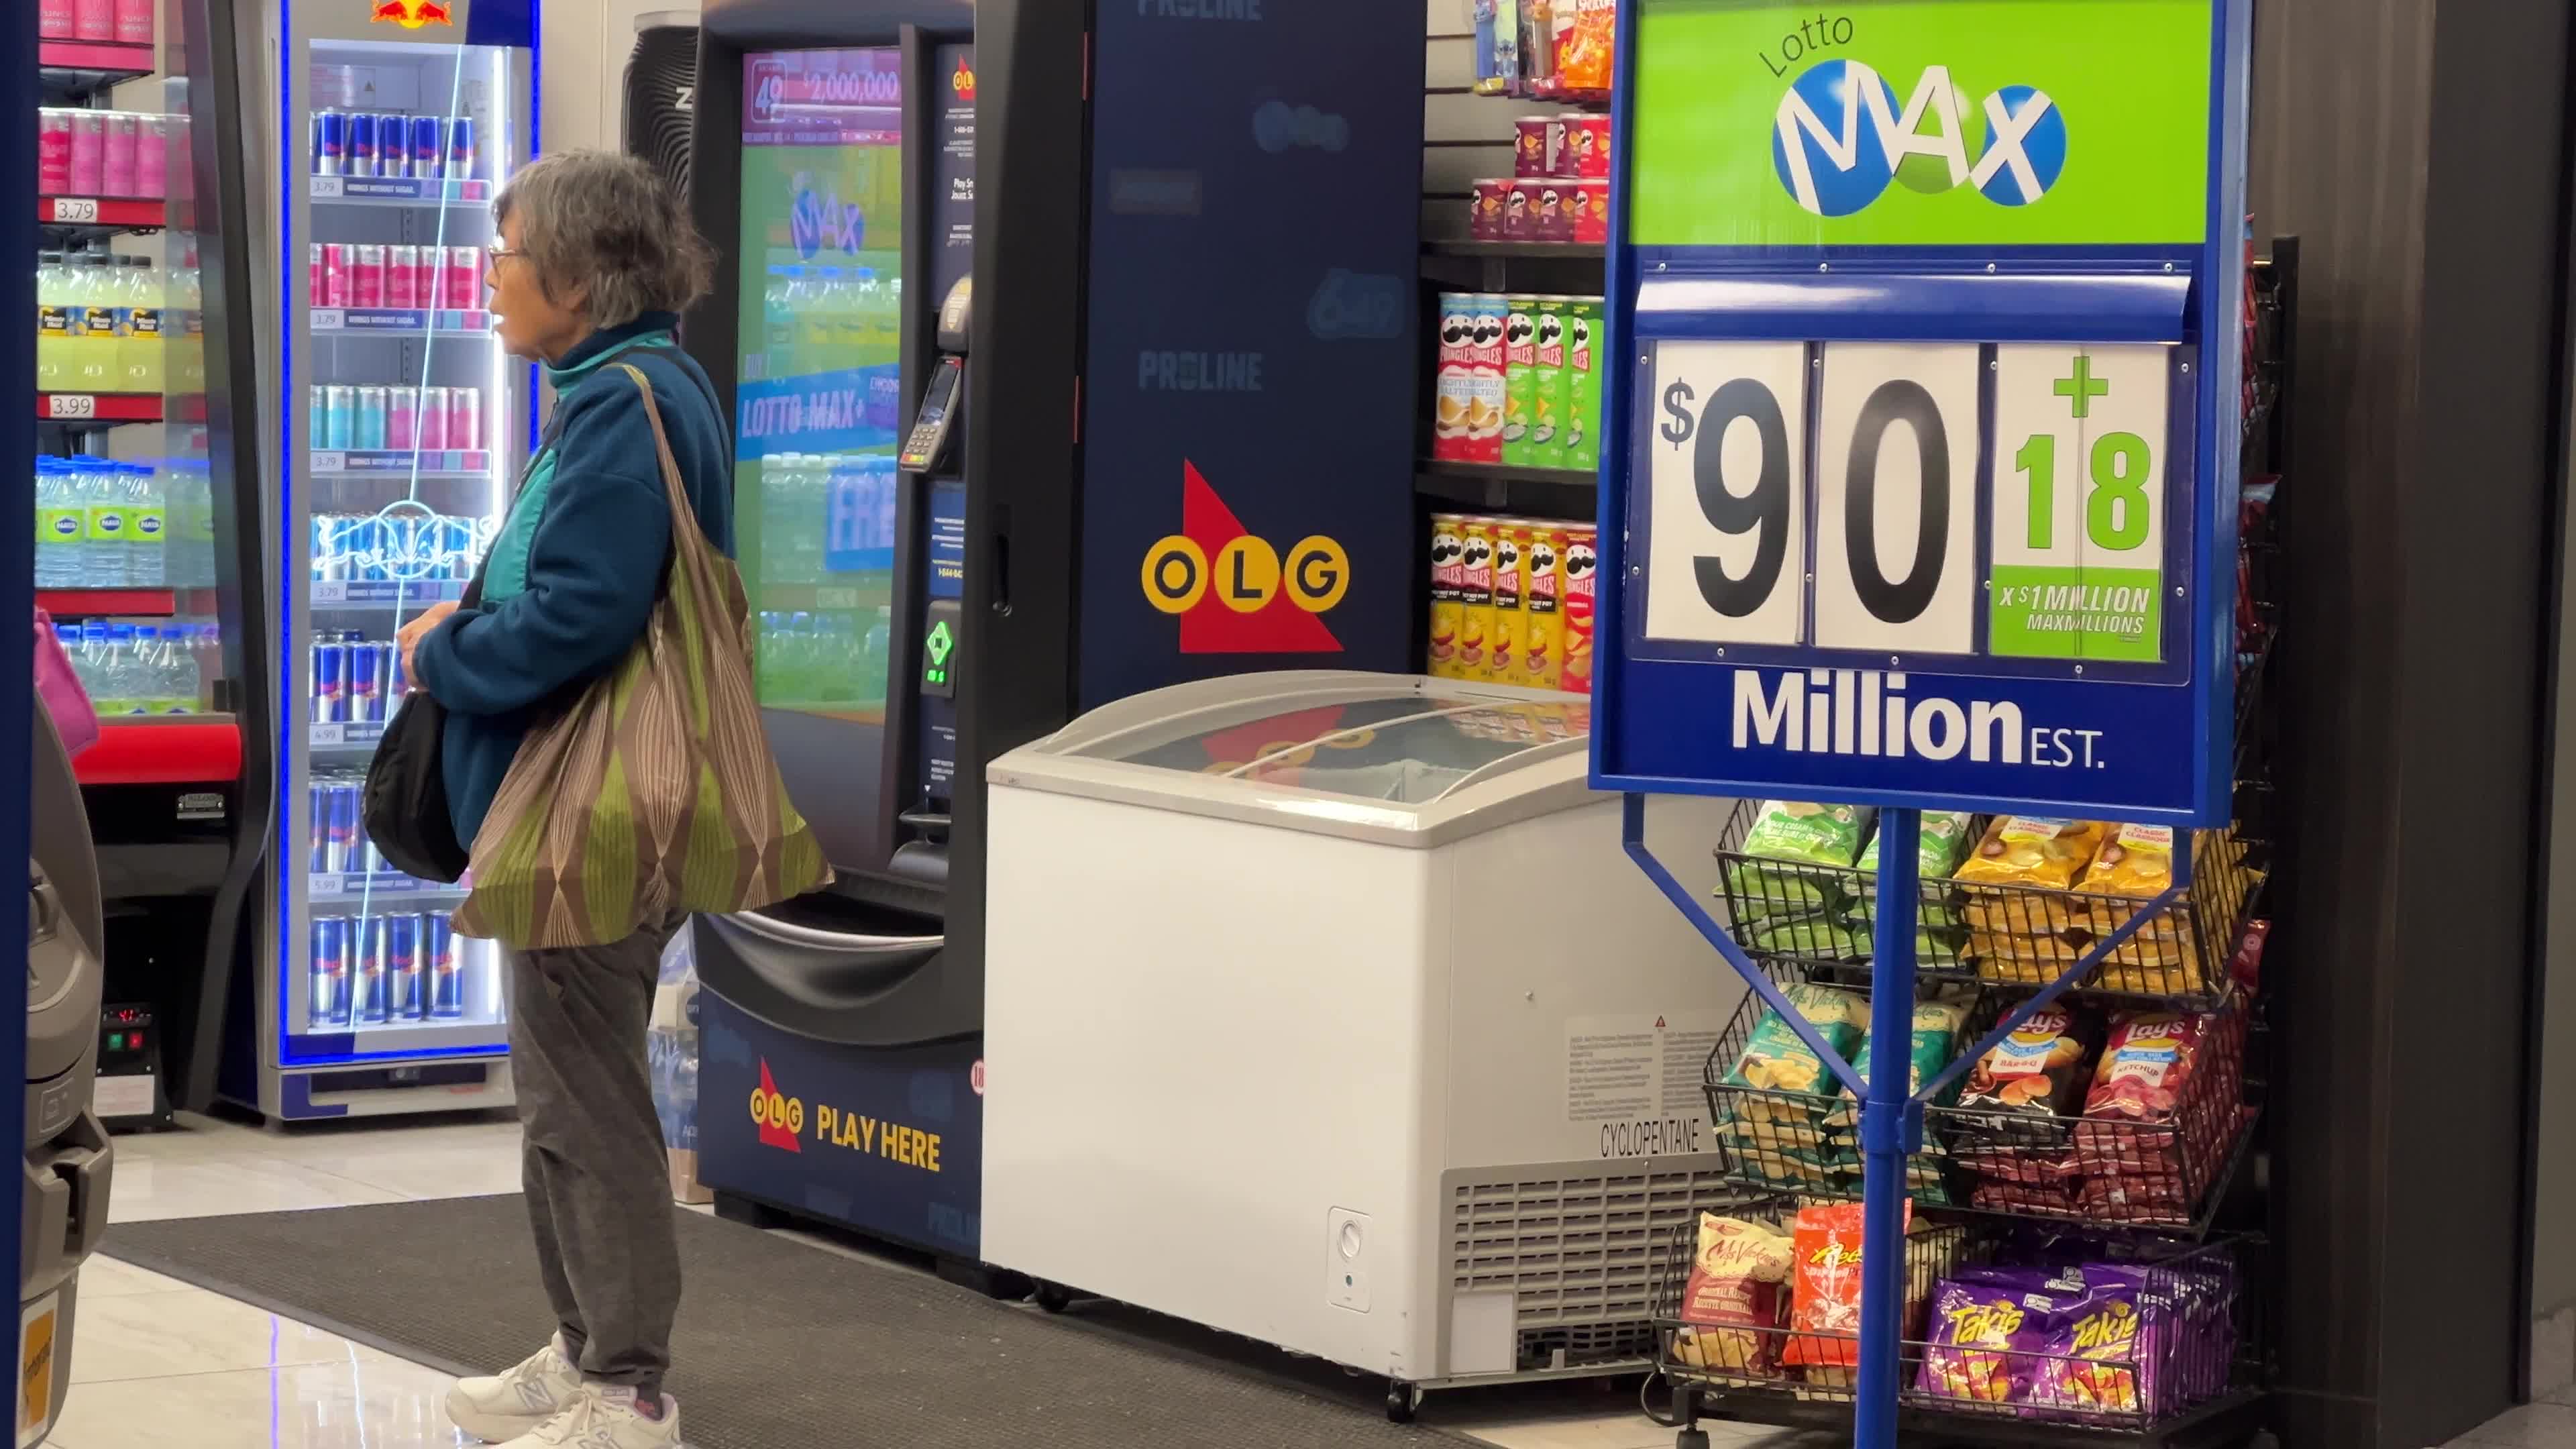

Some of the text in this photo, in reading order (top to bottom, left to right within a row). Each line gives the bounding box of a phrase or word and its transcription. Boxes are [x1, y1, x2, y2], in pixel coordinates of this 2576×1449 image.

[1758, 13, 1854, 78] Lotto
[58, 202, 94, 219] 3.79
[1138, 351, 1263, 391] PROLINE
[53, 397, 91, 415] 3.99
[742, 393, 802, 437] LOTTO
[808, 388, 857, 431] MAX
[2014, 431, 2151, 551] 18
[1150, 546, 1341, 602] OLG
[2044, 584, 2151, 614] MILLION
[2027, 613, 2145, 634] MAXMILLIONS
[1732, 669, 2105, 769] Million EST.
[2125, 1020, 2186, 1040] Lay's
[2116, 1064, 2159, 1077] KETCHUP
[752, 1093, 941, 1173] OLG PLAY HERE
[1601, 1118, 1699, 1159] CYCLOPENTANE
[1950, 1301, 2025, 1346] Takis
